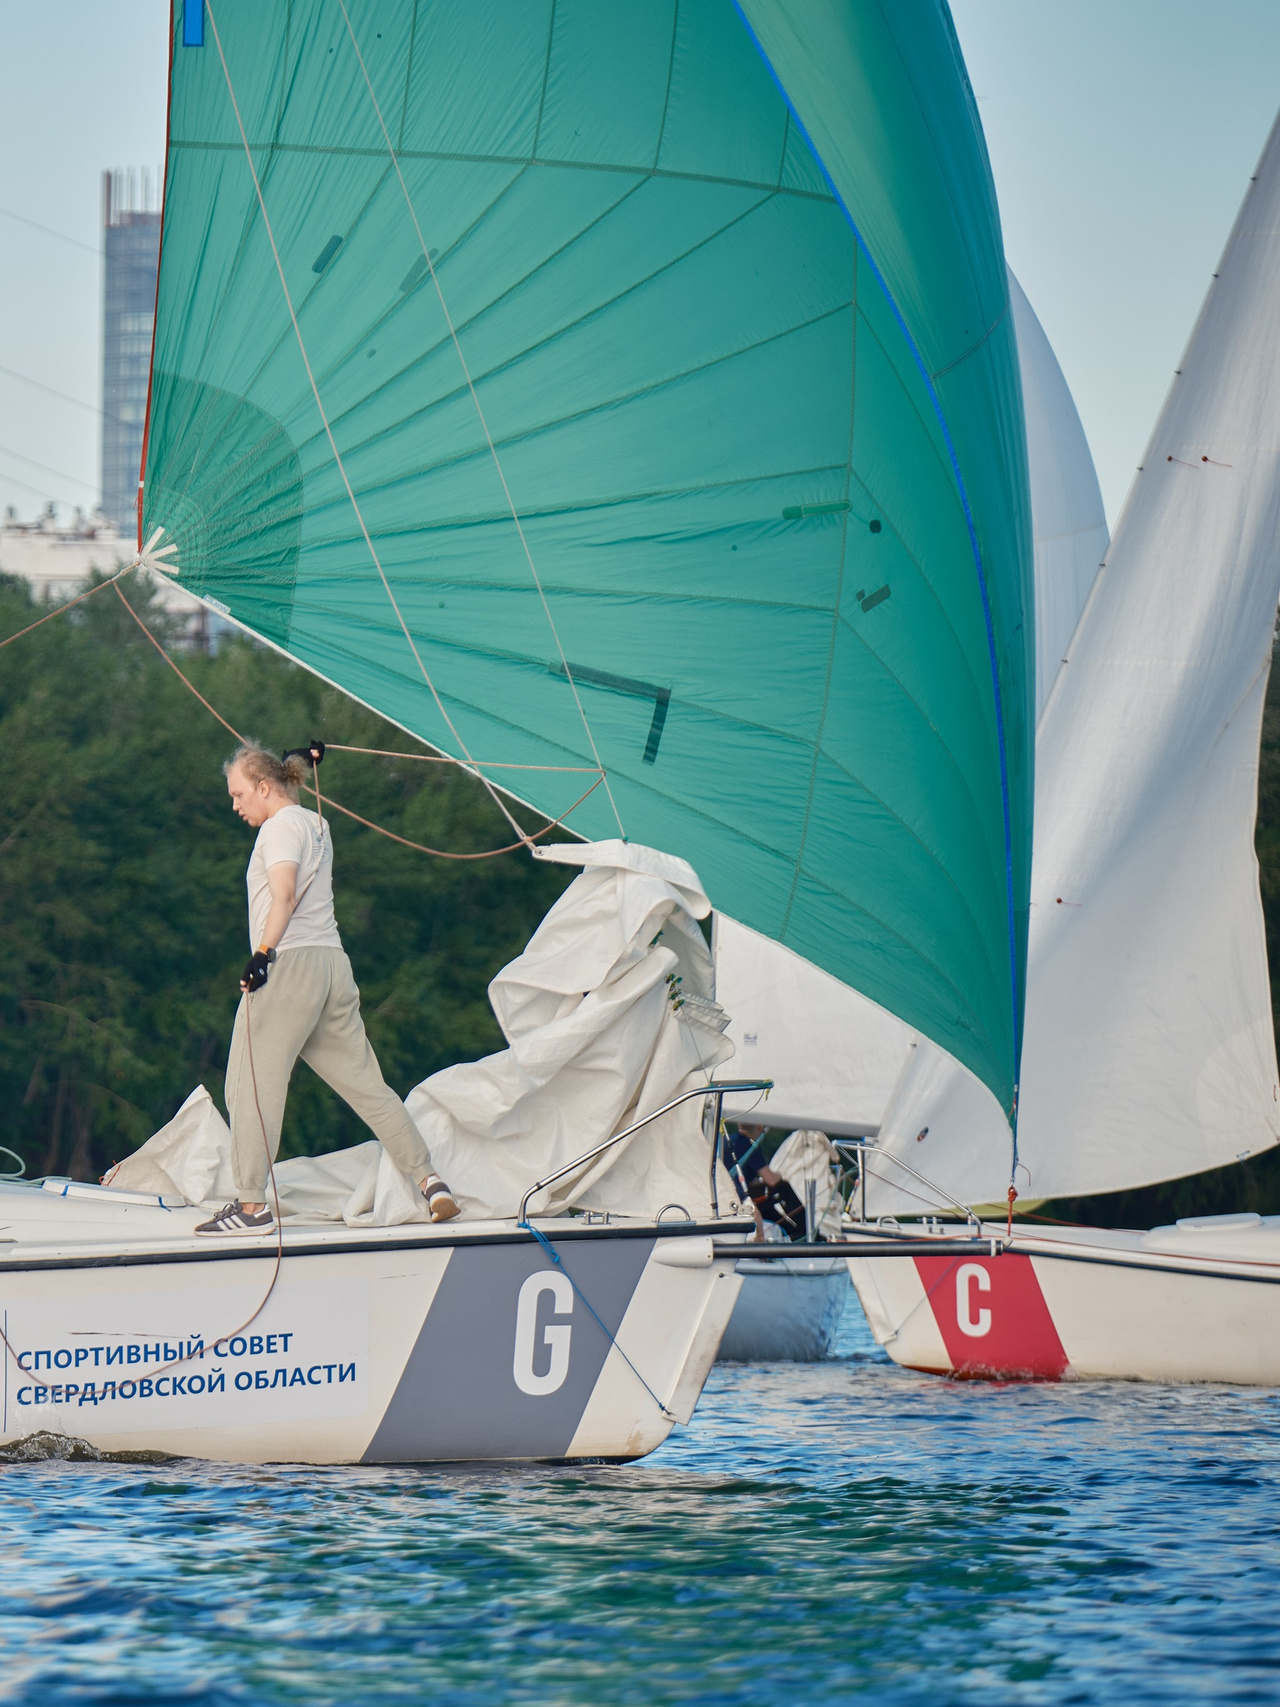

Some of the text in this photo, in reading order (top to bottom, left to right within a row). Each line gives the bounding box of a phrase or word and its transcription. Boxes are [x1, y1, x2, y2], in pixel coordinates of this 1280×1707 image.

[956, 1263, 991, 1337] C
[17, 1333, 293, 1371] СПОРТИВНЫЙ СОВЕТ
[513, 1270, 574, 1396] G
[16, 1363, 356, 1406] СВЕРДЛОВСКОЙ ОБЛАСТИ
